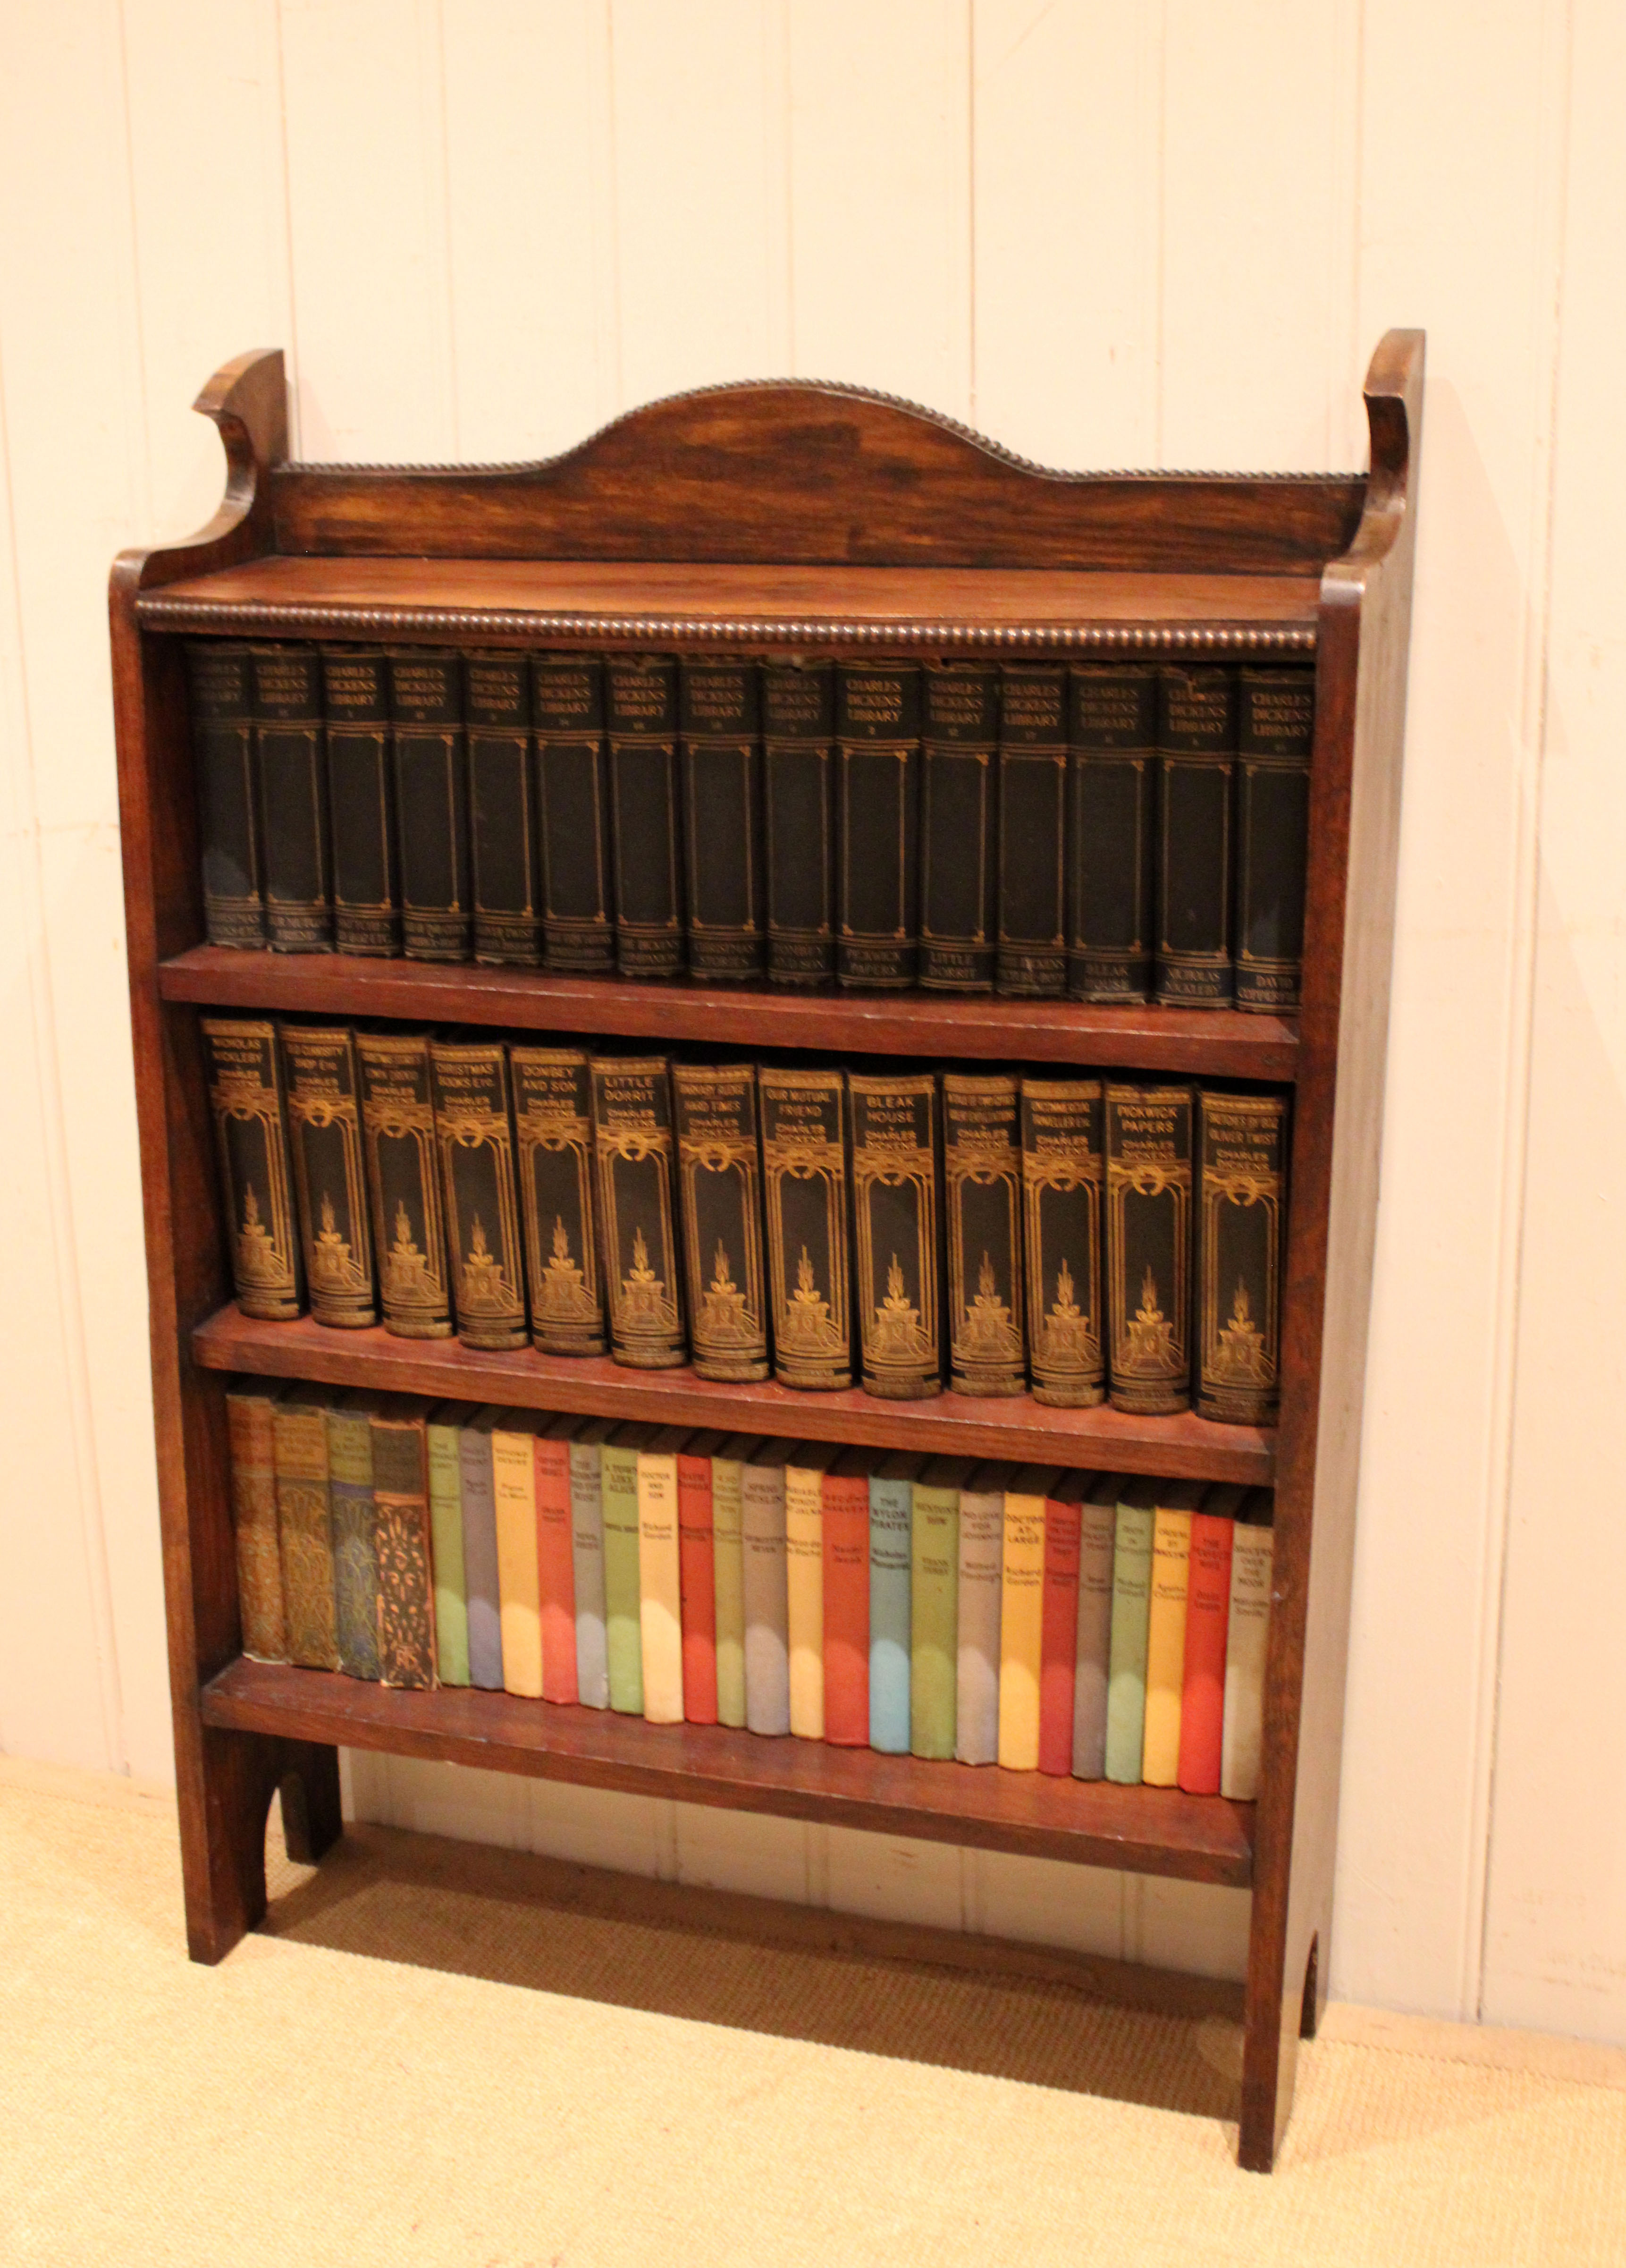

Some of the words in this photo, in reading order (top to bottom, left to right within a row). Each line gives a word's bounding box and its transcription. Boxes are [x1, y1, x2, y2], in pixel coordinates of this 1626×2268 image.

[521, 1078, 548, 1092] AND
[549, 1080, 577, 1092] SON
[604, 1075, 655, 1089] LITTLE
[604, 1088, 656, 1102] DORRIT
[866, 1095, 915, 1109] BLEAK
[867, 1110, 916, 1124] HOUSE
[1118, 1105, 1178, 1119] PICKWICK
[1122, 1119, 1174, 1134] PAPERS
